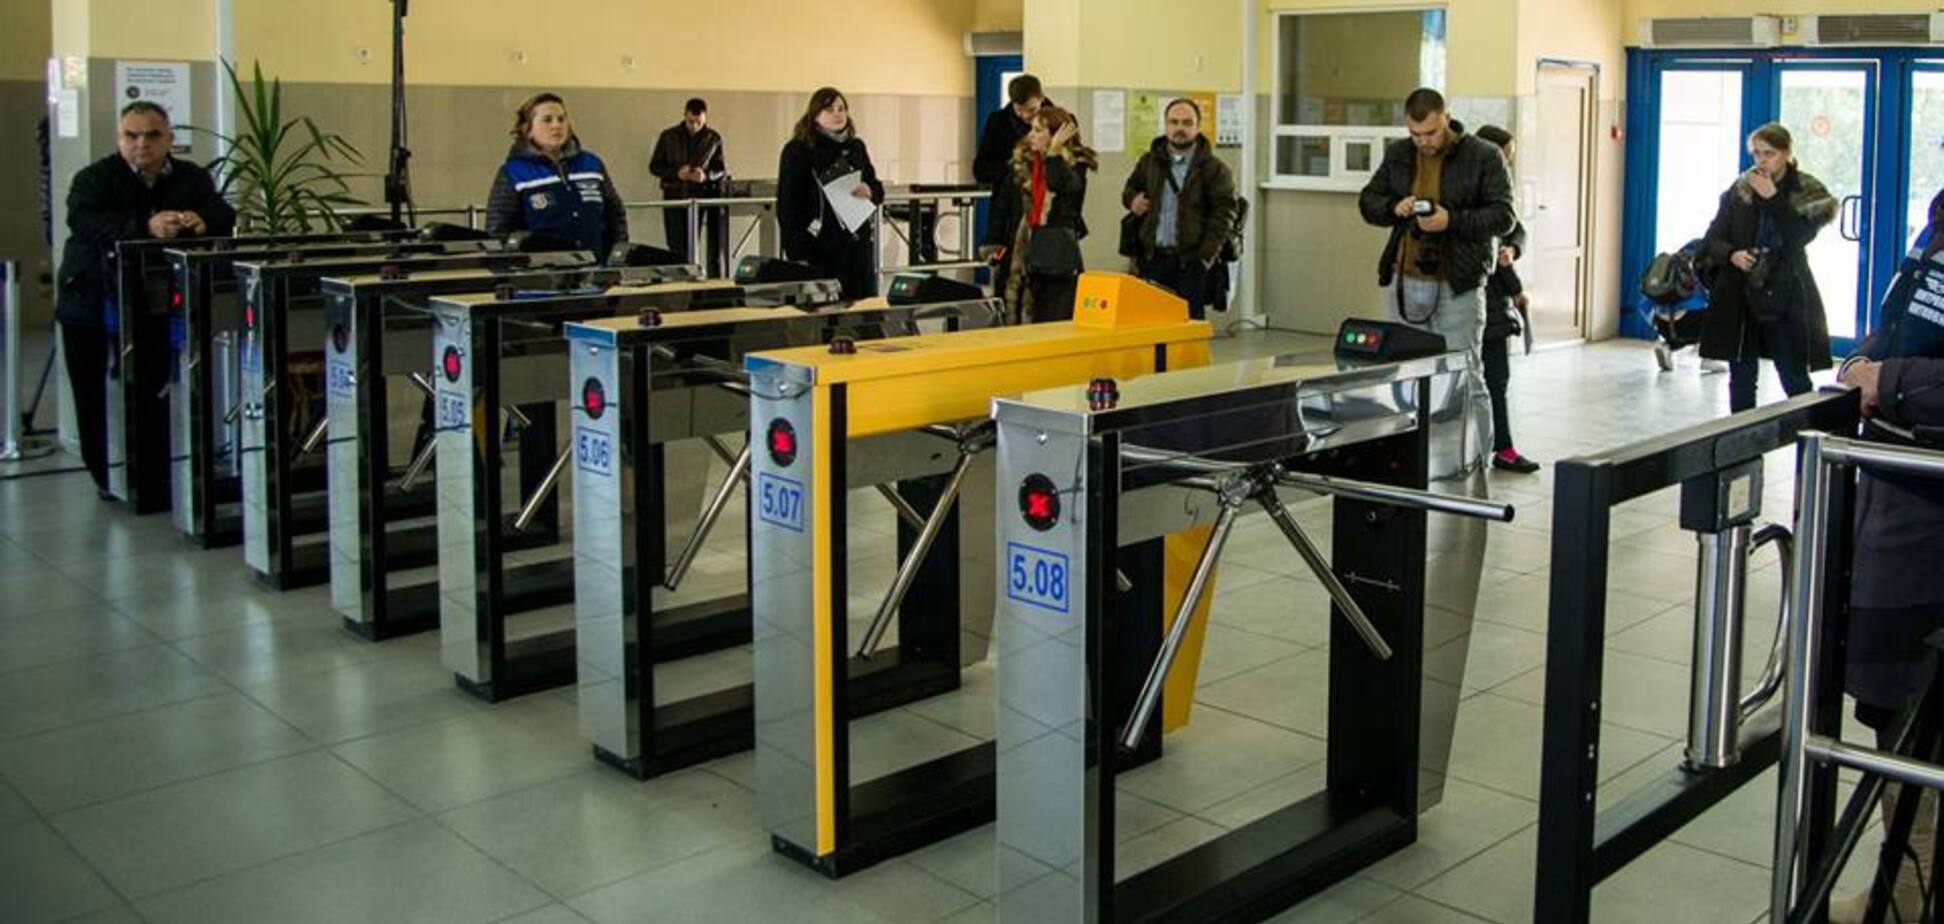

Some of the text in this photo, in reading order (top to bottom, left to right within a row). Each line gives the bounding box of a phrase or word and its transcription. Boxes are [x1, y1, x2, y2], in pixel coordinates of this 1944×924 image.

[580, 434, 609, 468] 5.06
[763, 483, 801, 521] 5.07
[1012, 554, 1064, 602] 5.08
